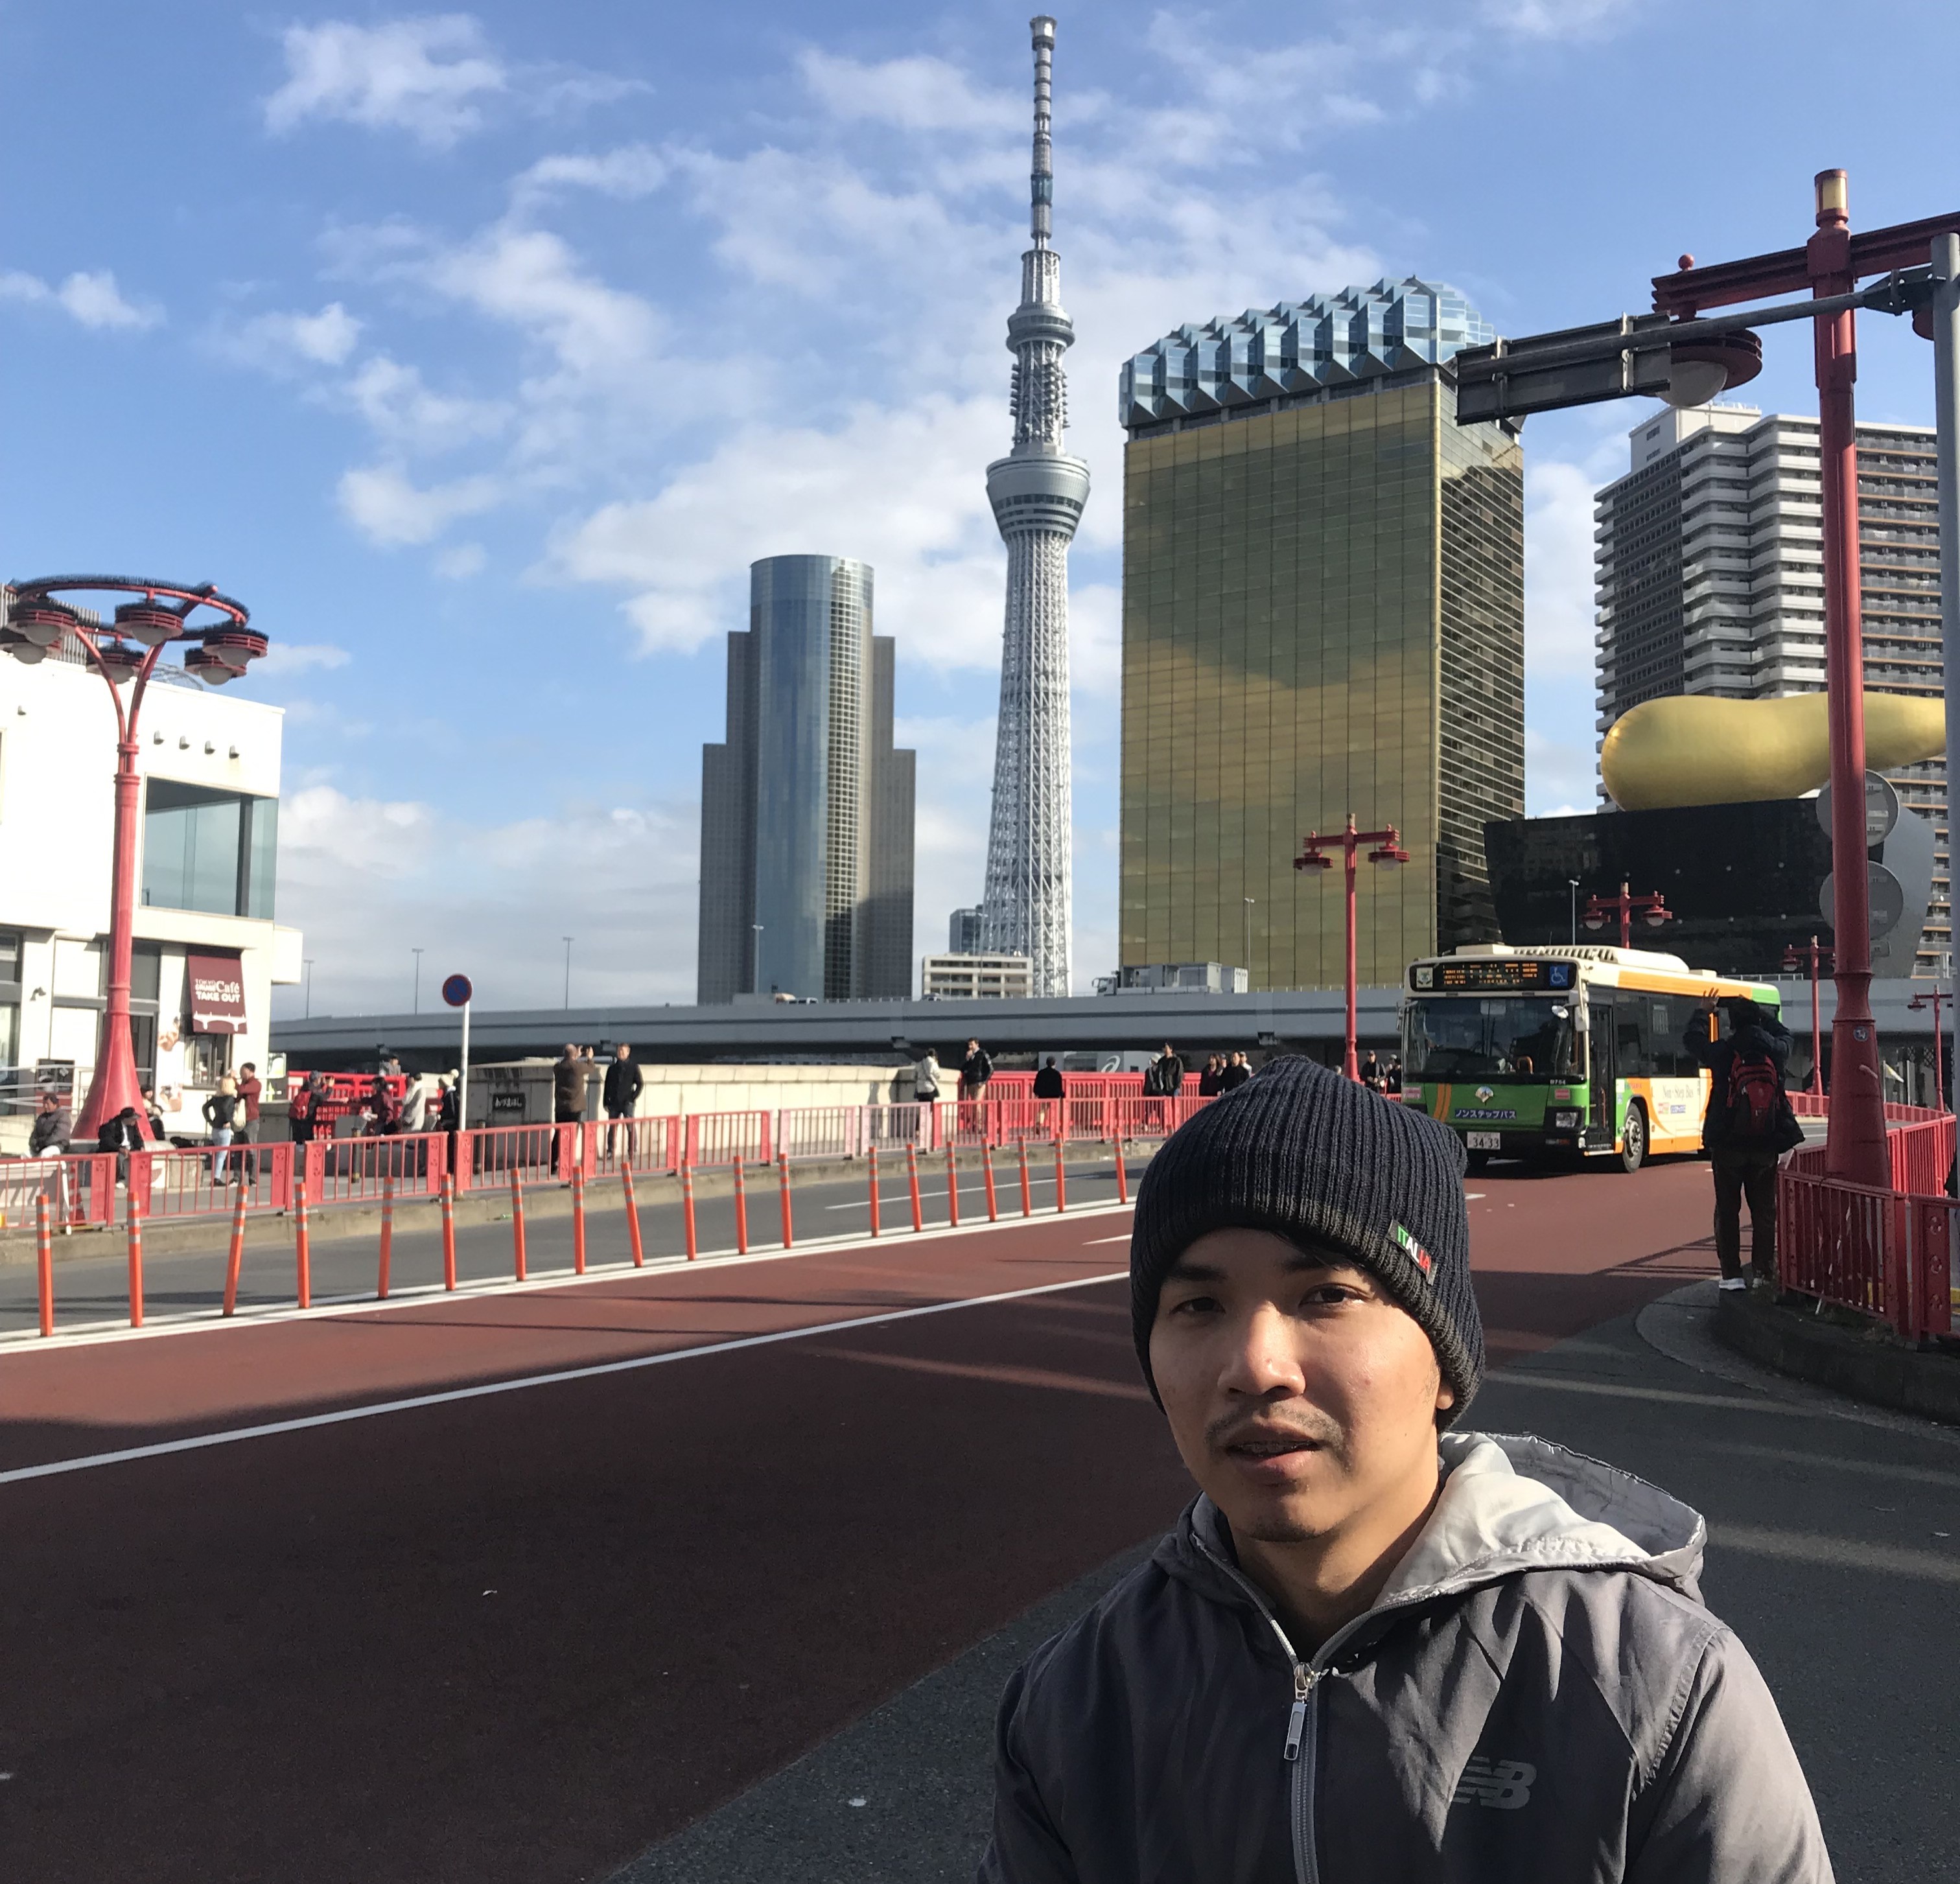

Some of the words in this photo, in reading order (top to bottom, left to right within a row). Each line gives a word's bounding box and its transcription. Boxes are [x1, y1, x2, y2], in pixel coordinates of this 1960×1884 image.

[216, 980, 240, 994] Café
[196, 991, 220, 1001] TAKE
[221, 993, 240, 1003] OUT
[1456, 1110, 1516, 1119] ノンステップバス
[1397, 1226, 1431, 1276] ITALIA
